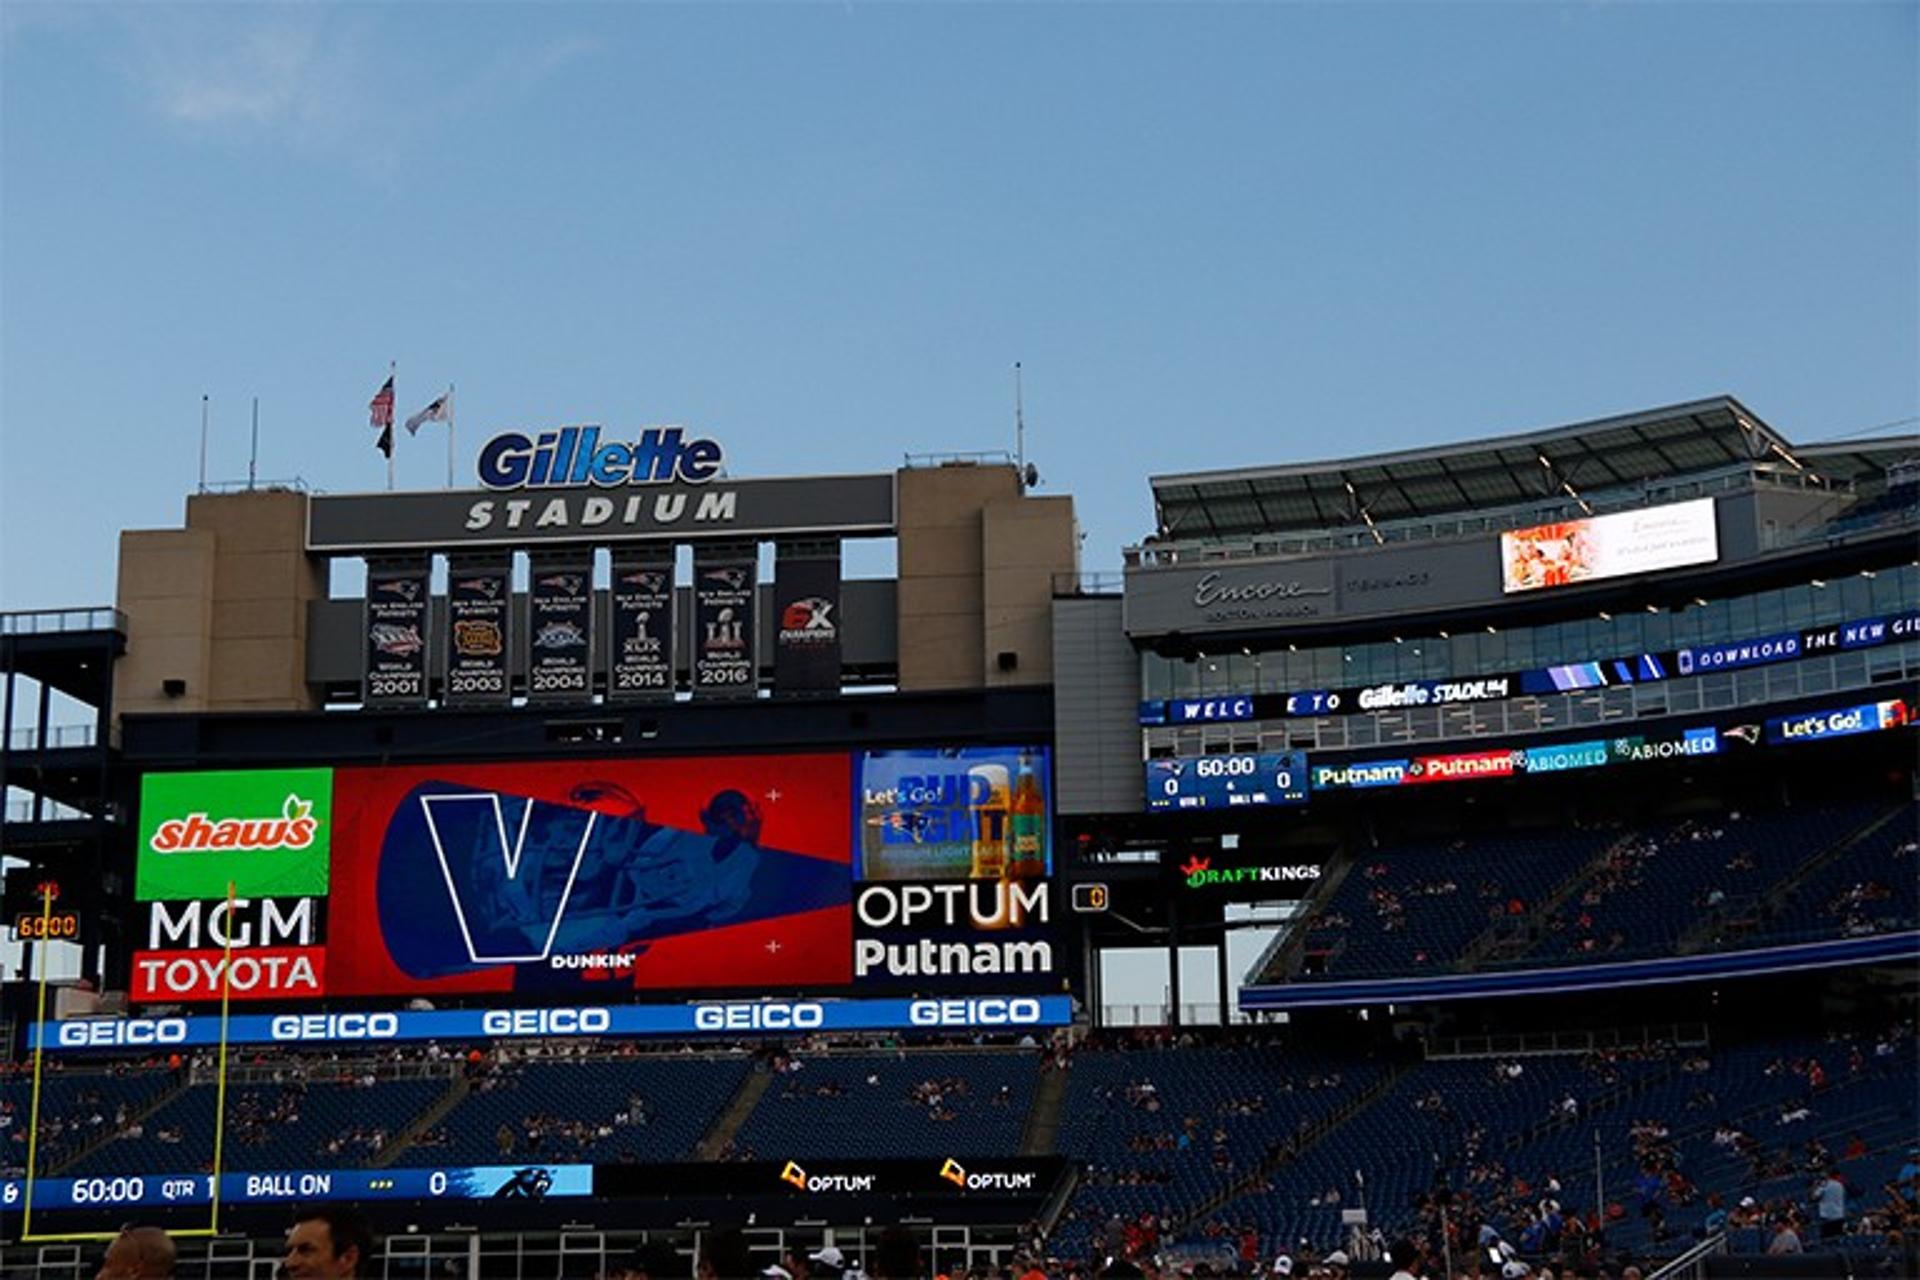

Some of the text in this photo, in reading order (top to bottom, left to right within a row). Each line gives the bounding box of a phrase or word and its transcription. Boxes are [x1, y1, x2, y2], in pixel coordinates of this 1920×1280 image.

[477, 425, 723, 490] Gillette
[465, 492, 737, 530] STADIUM
[1193, 570, 1331, 607] Encore
[1699, 639, 1797, 667] DOWNLOAD
[1805, 631, 1838, 650] THE
[1845, 623, 1885, 643] NEW
[371, 679, 419, 695] 2001
[451, 677, 502, 691] 2003
[533, 674, 585, 690] 2004
[618, 672, 665, 687] 2014
[700, 669, 748, 684] 2016
[1358, 684, 1428, 709] Gillette
[1782, 710, 1863, 738] Let's Go!
[1526, 748, 1609, 773] ABIOMED
[1630, 737, 1716, 762] ABIOMED
[1196, 757, 1256, 777] 60:00
[1318, 764, 1404, 785] Putnam
[1427, 754, 1513, 777] Putnam
[1164, 778, 1179, 796] 0
[1276, 771, 1291, 789] 0
[865, 786, 943, 804] Let's Go!
[1186, 864, 1321, 888] DRAFTKINGS
[856, 882, 1049, 927] OPTUM
[149, 897, 312, 950] MGM
[855, 939, 1052, 977] Putnam
[139, 956, 318, 993] TOYOTA
[483, 1008, 611, 1035] GEICO
[694, 1003, 824, 1029] GEICO
[909, 999, 1041, 1025] GEICO
[60, 1018, 187, 1045] GEICO
[272, 1013, 399, 1040] GEICO
[71, 1177, 144, 1203] 60:00
[161, 1179, 196, 1199] QTR
[246, 1174, 331, 1198] BALL ON
[429, 1172, 447, 1196] 0
[807, 1175, 872, 1192] OPTUM
[967, 1172, 1032, 1190] OPTUM
